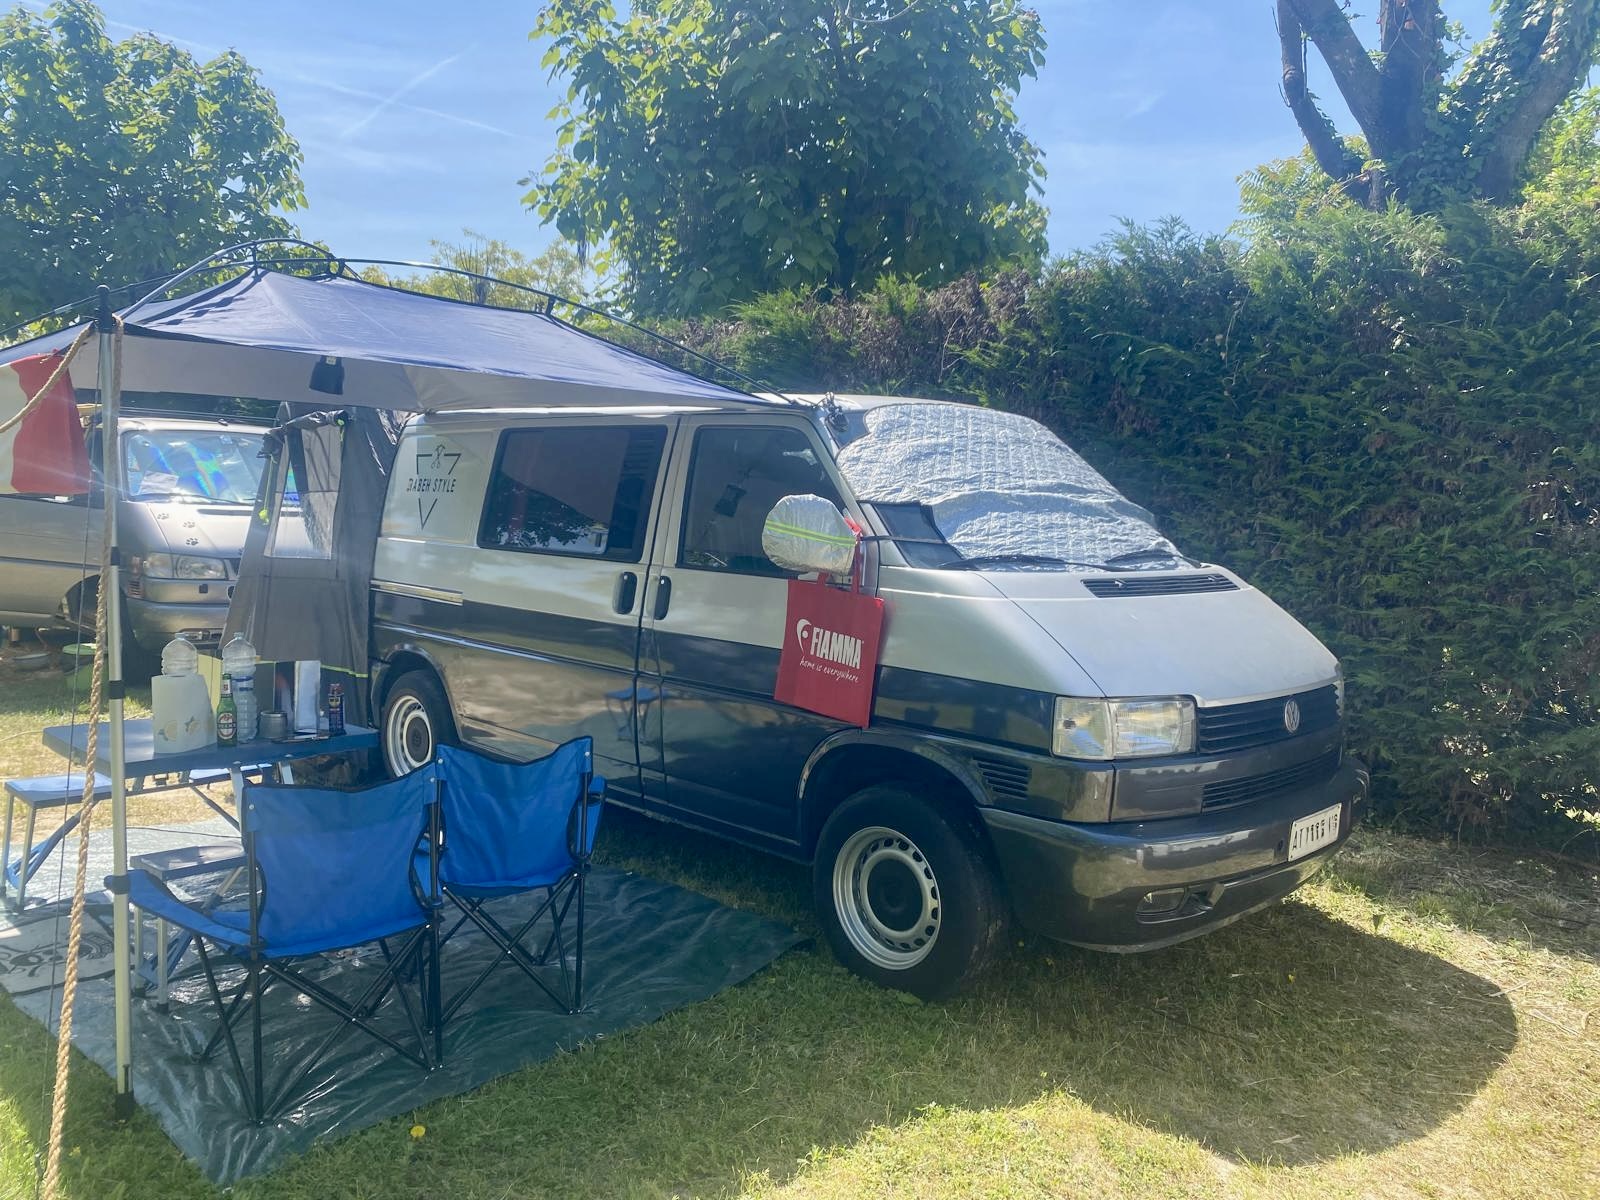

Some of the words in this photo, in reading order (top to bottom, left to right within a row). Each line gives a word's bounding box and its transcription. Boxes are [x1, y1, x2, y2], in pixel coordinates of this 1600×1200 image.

[433, 478, 457, 493] STYLE
[810, 626, 862, 670] FIAMMA
[799, 656, 815, 669] home
[823, 668, 859, 683] everywhere
